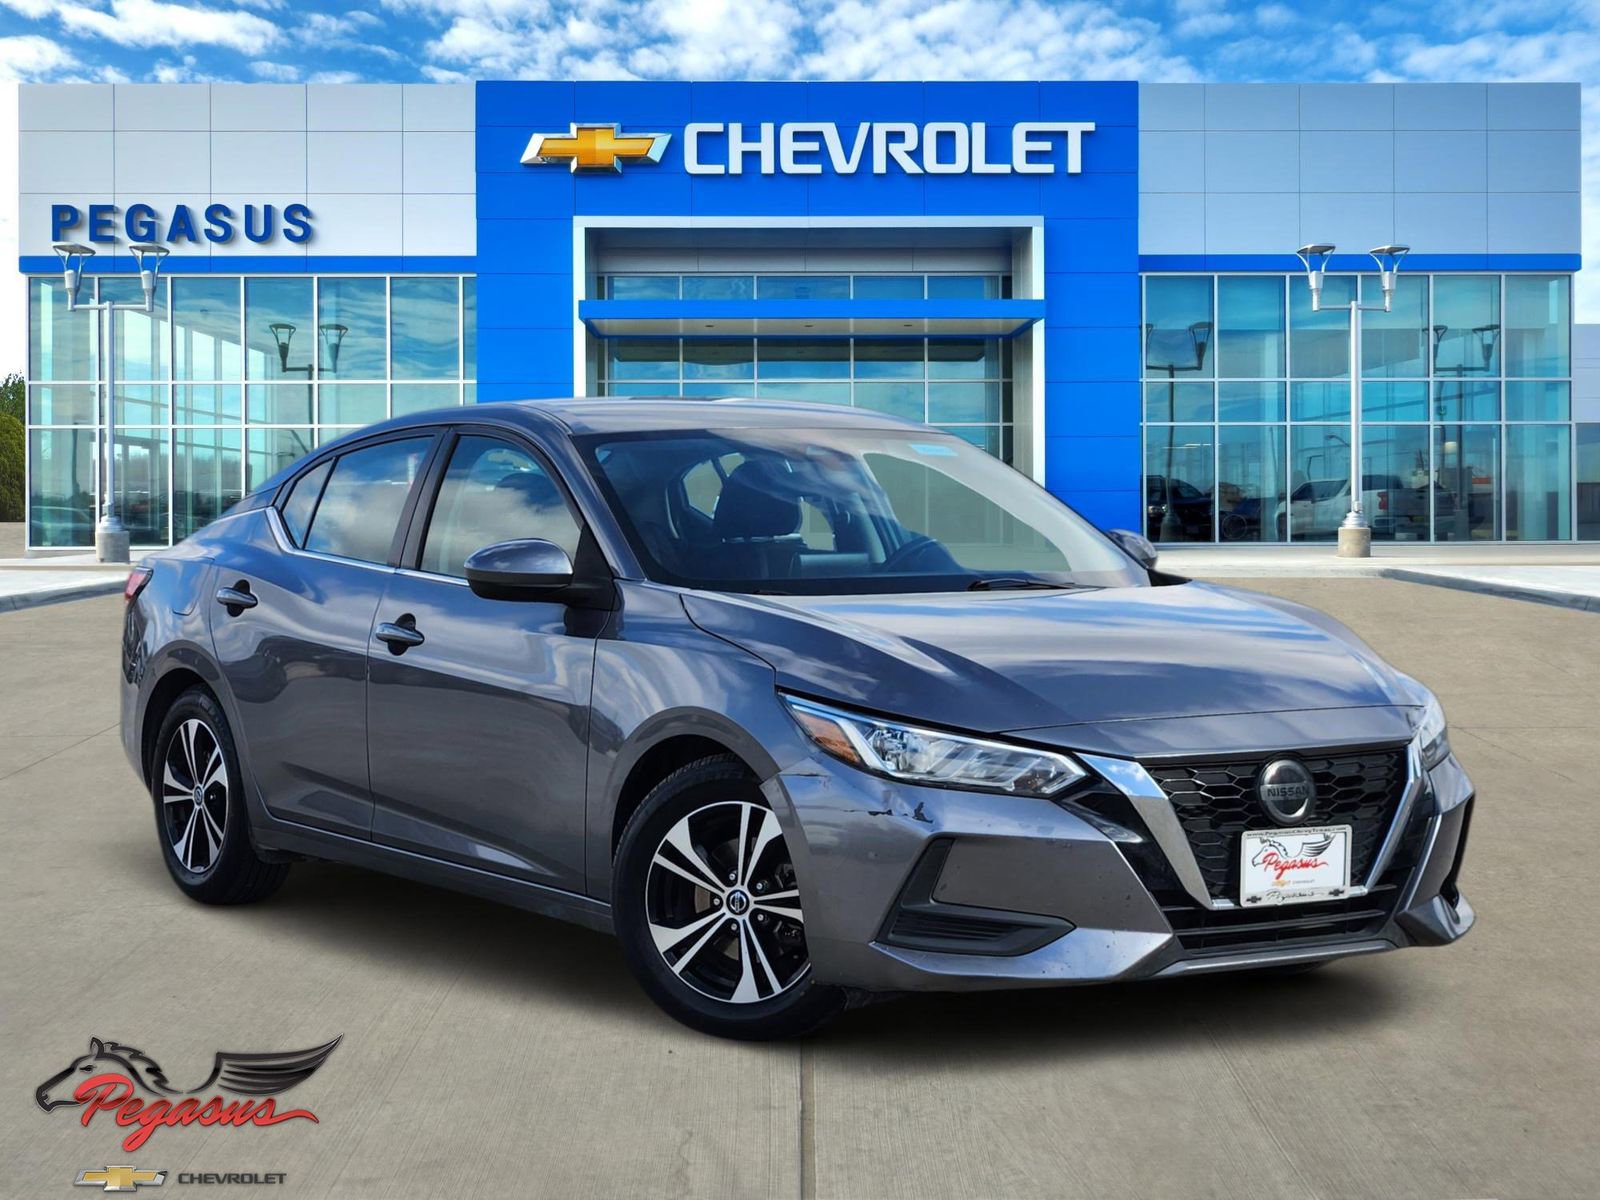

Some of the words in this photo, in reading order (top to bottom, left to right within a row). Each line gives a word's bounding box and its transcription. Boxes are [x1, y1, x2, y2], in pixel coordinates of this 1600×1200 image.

[684, 121, 1096, 175] CHEVROLET
[51, 203, 314, 243] PEGASUS
[1266, 787, 1308, 798] NISSAN
[1263, 852, 1328, 880] Pegasus
